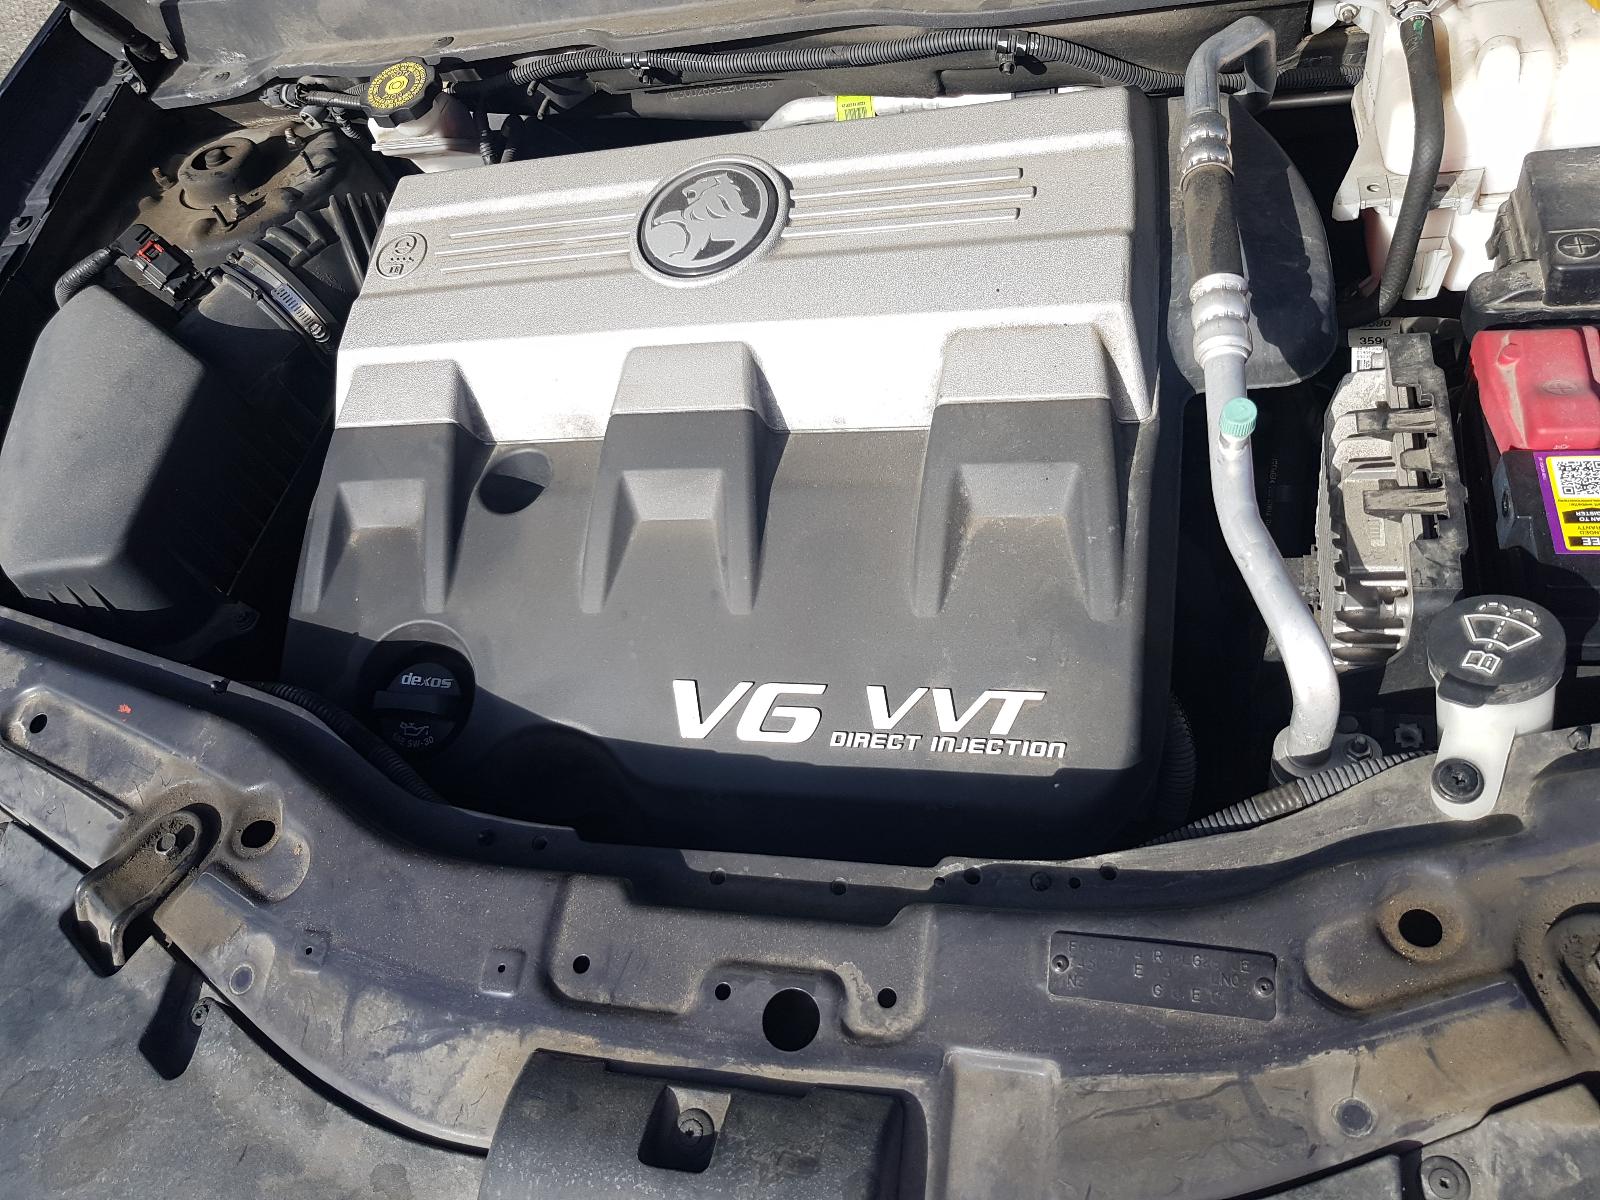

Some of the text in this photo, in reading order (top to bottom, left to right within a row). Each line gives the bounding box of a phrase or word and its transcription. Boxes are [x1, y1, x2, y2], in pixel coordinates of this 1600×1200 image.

[401, 672, 454, 689] dexos
[672, 679, 1047, 743] V6 VVT
[830, 731, 1067, 759] DIRECT INJECTION
